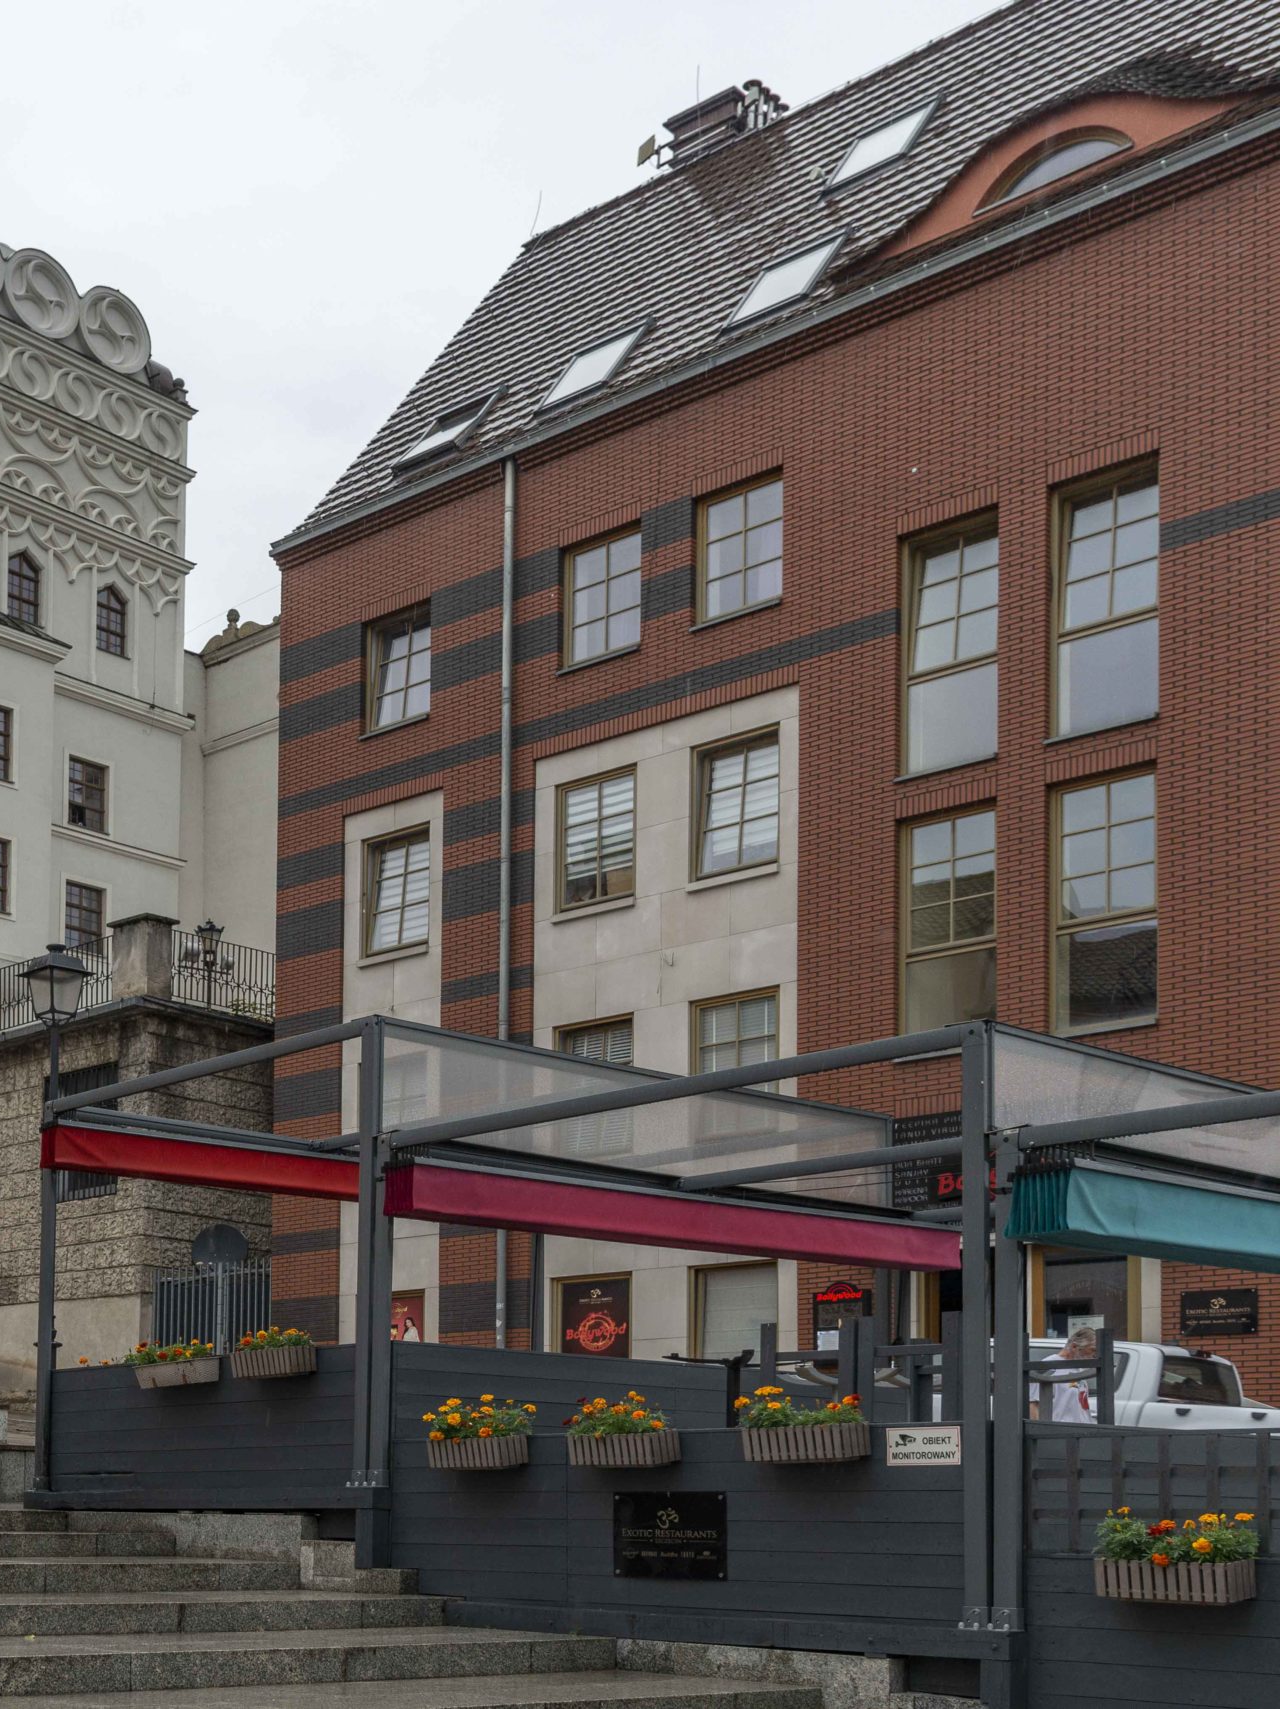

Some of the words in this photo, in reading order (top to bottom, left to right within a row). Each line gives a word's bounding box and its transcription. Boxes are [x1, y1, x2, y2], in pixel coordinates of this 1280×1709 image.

[816, 1290, 863, 1302] Bollywood
[922, 1436, 951, 1445] OBIEKT
[892, 1451, 956, 1460] MONITOROWANY
[622, 1528, 653, 1538] EXOTIC
[655, 1528, 718, 1538] RESTAURANTS
